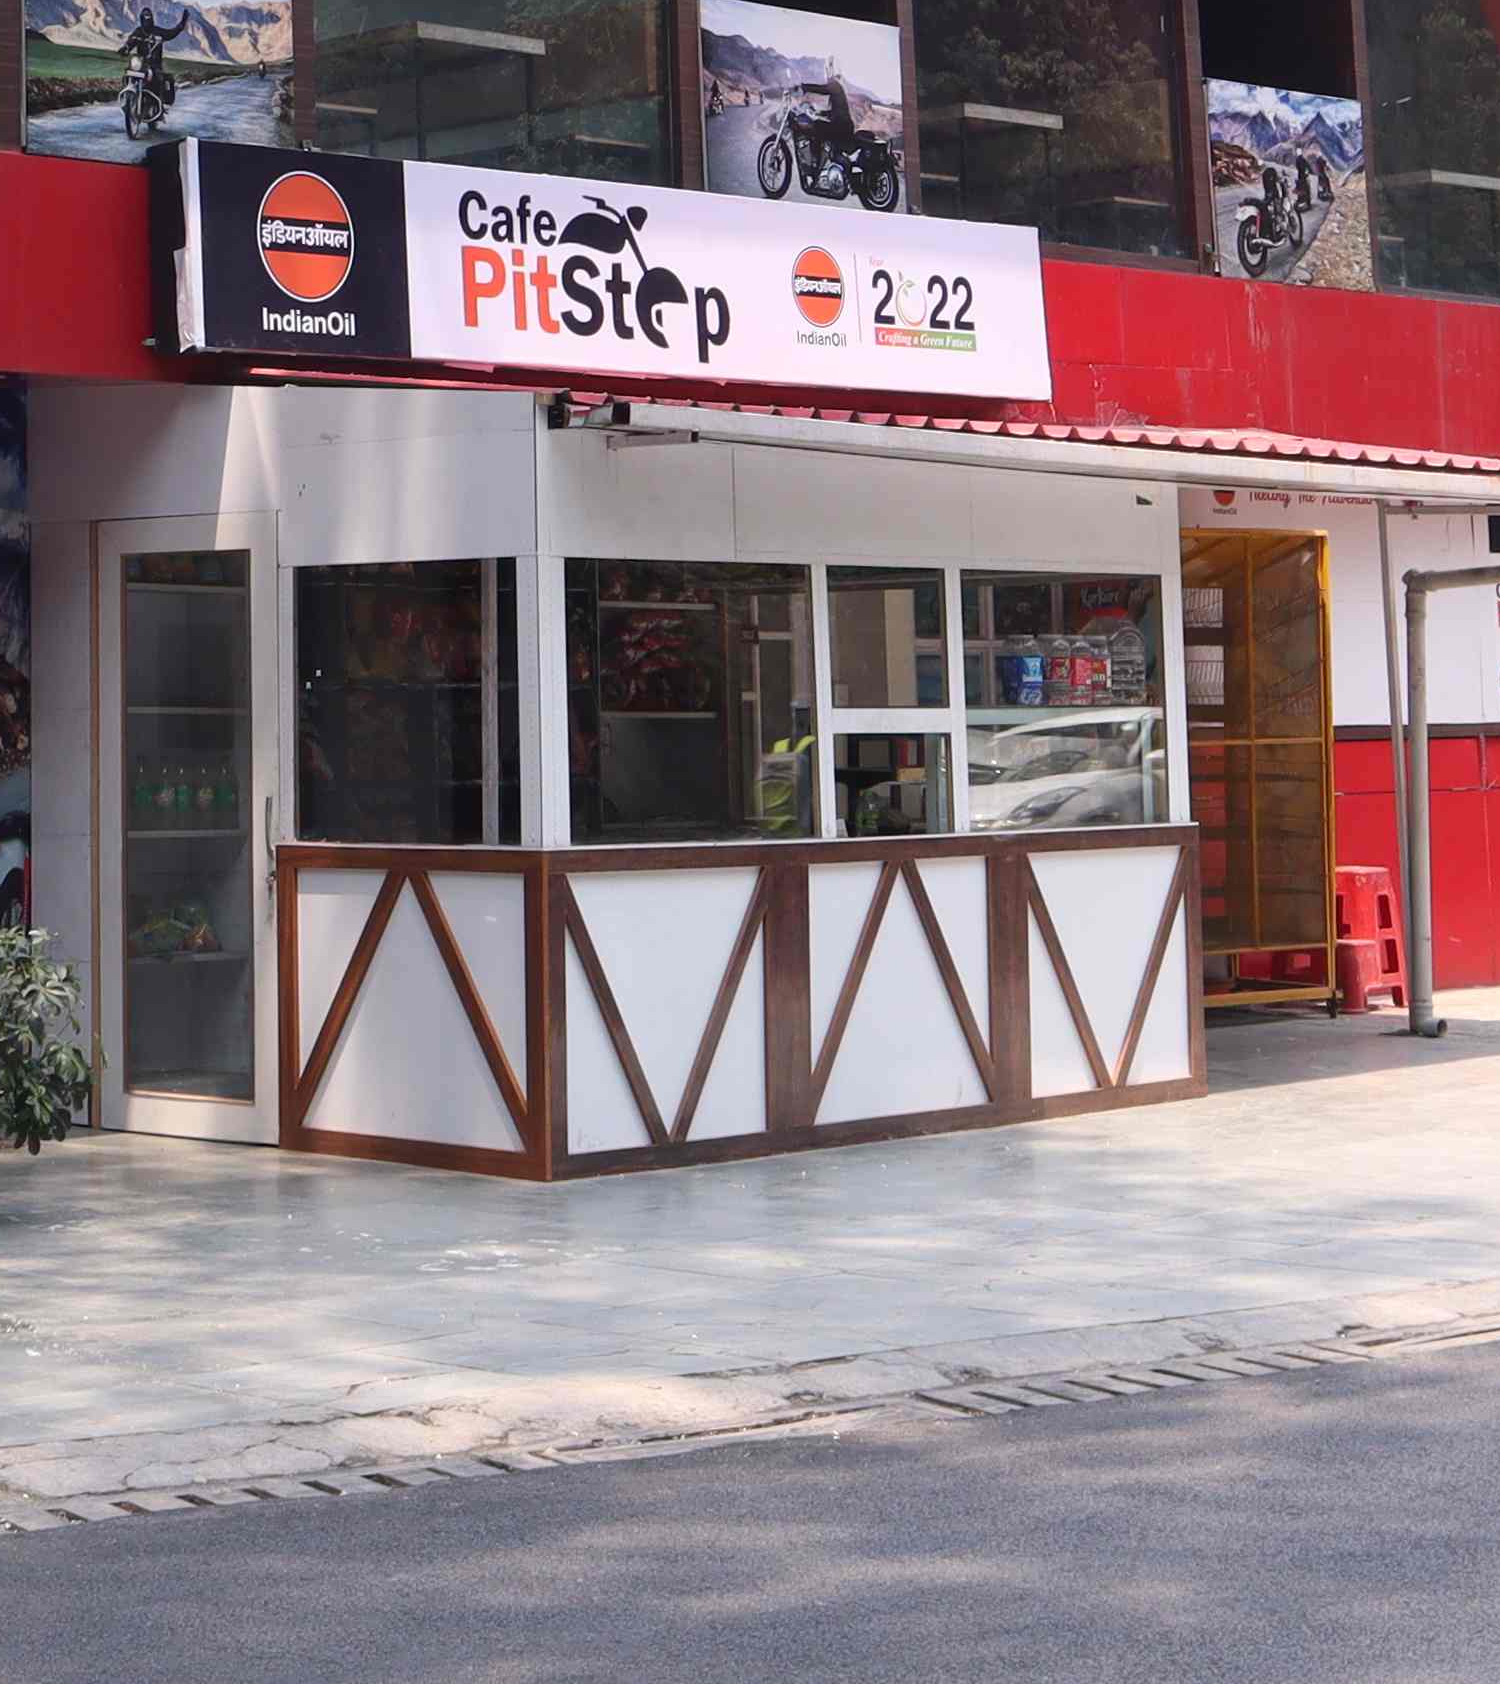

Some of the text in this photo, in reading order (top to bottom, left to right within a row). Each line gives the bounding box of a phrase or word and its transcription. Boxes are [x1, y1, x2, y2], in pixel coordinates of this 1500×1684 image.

[459, 190, 557, 246] Cafe
[261, 220, 349, 249] इंडियनऑयल
[461, 246, 730, 363] PitStop
[872, 269, 975, 331] 2022
[262, 307, 356, 336] IndianOil
[797, 331, 847, 348] IndianOil
[878, 330, 912, 347] Crafting
[920, 334, 945, 348] Green
[946, 336, 973, 349] Future
